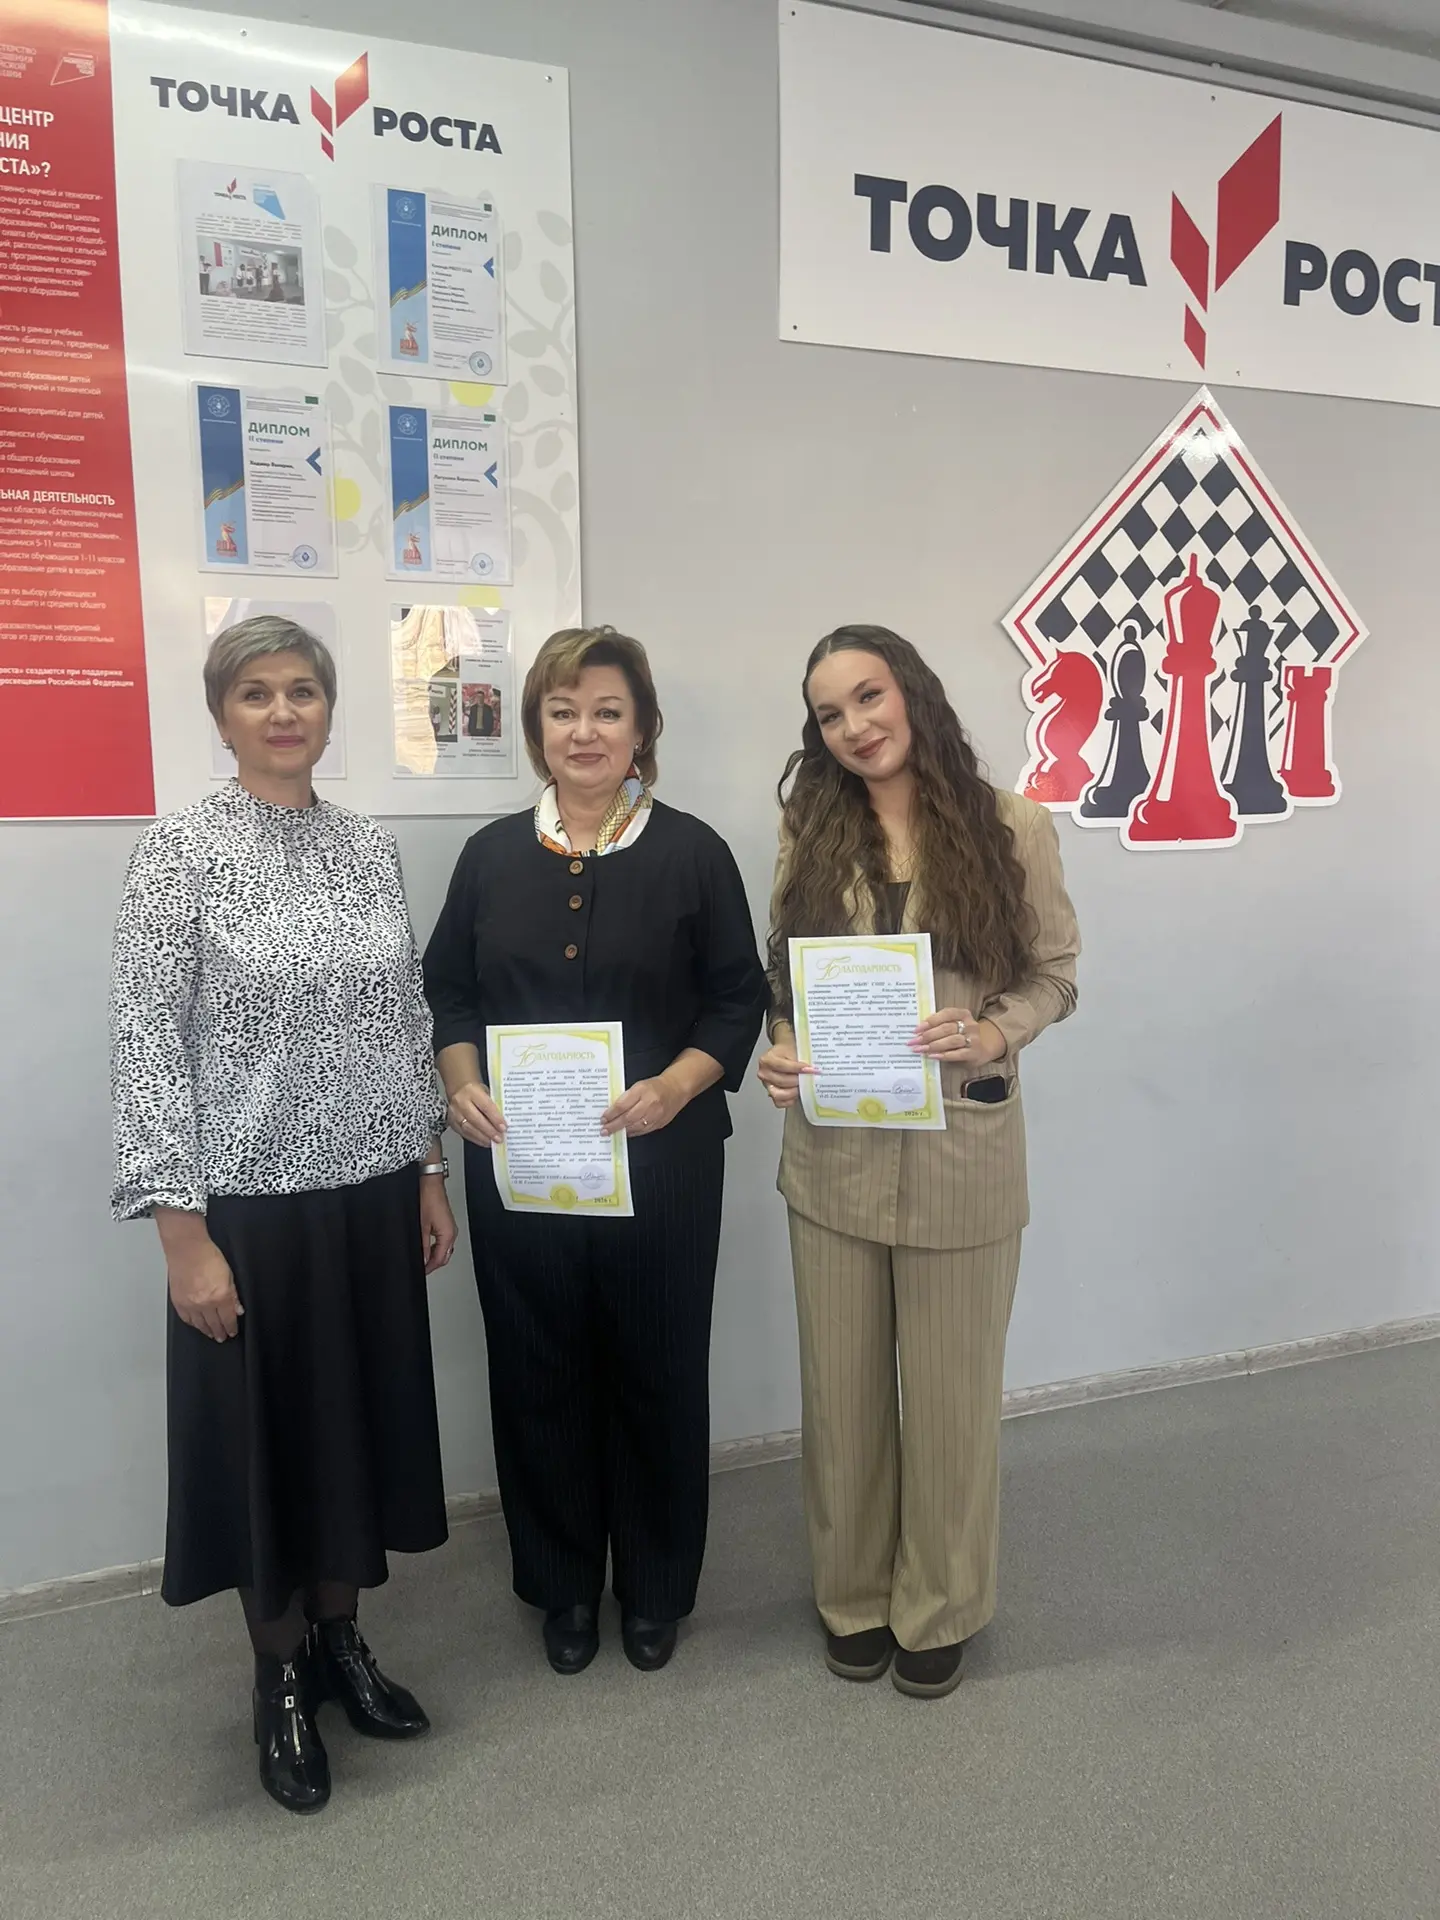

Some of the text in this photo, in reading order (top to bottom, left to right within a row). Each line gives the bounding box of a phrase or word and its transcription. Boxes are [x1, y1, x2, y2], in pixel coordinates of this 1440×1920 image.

[0, 106, 54, 127] ЦЕНТР
[151, 76, 502, 155] ТОЧКА РОСТА
[0, 157, 50, 177] СТА»?
[431, 224, 488, 243] ДИПЛОМ
[854, 172, 1147, 287] ТОЧКА
[248, 422, 310, 437] ДИПЛОМ
[432, 438, 488, 452] ДИПЛОМ
[33, 490, 116, 506] ДЕЯТЕЛЬНОСТЬ
